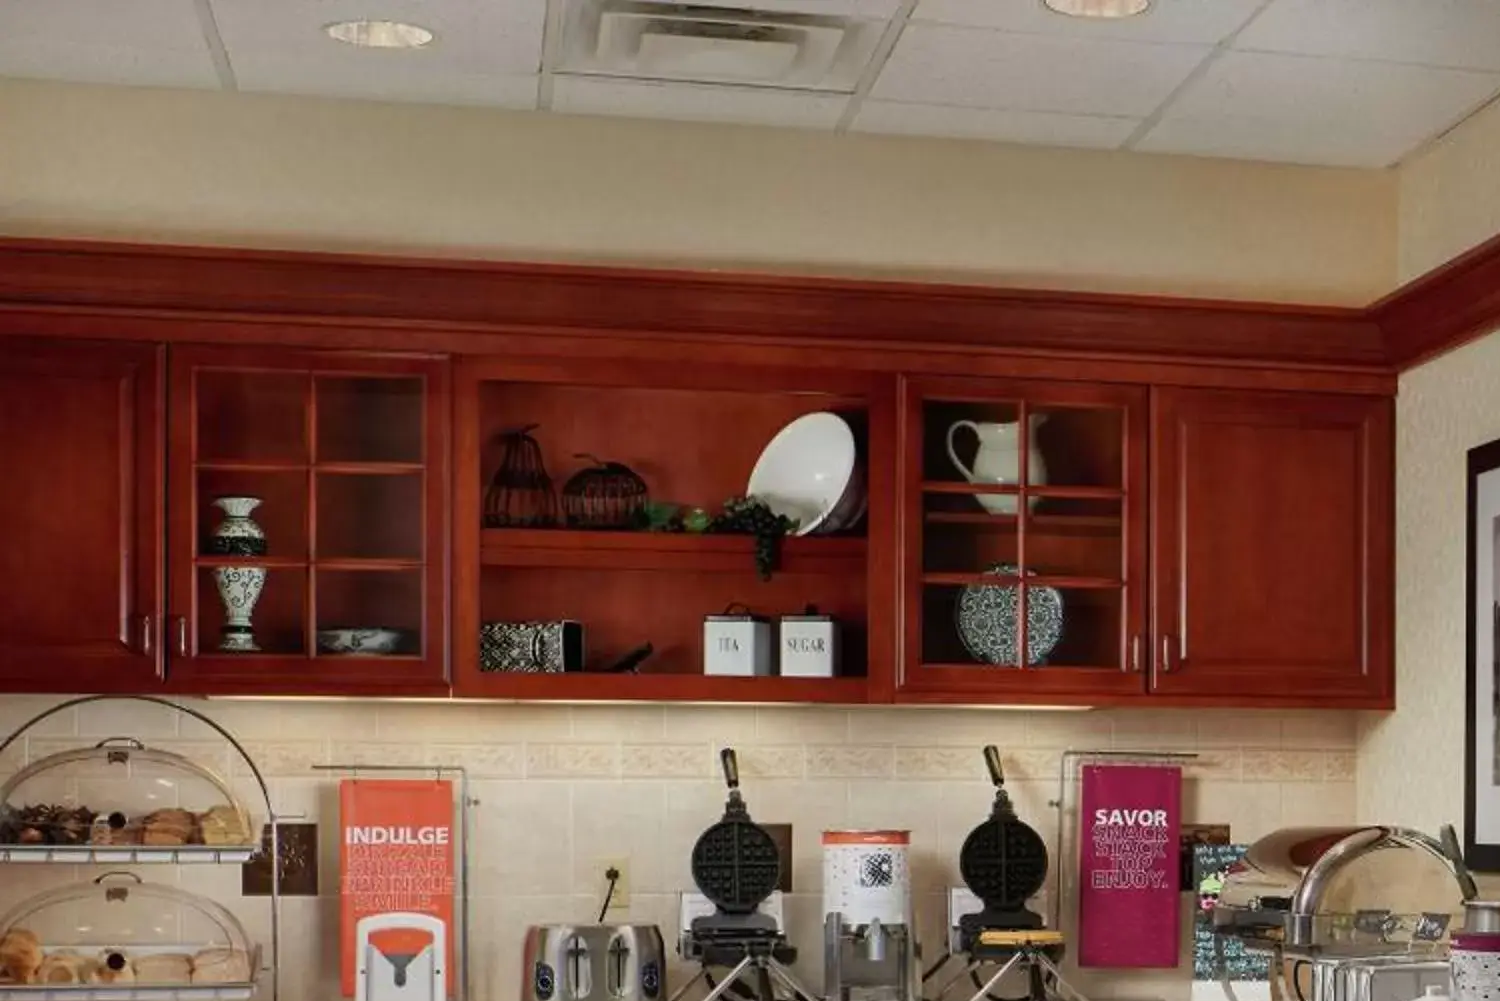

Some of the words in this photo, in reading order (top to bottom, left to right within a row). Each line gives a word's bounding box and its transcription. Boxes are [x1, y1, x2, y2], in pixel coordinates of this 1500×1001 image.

[787, 637, 826, 653] SUGAR
[1095, 809, 1168, 827] SAVOR
[345, 826, 450, 845] INDULGE
[1091, 825, 1169, 843] SNACK
[1095, 841, 1167, 857] STACK
